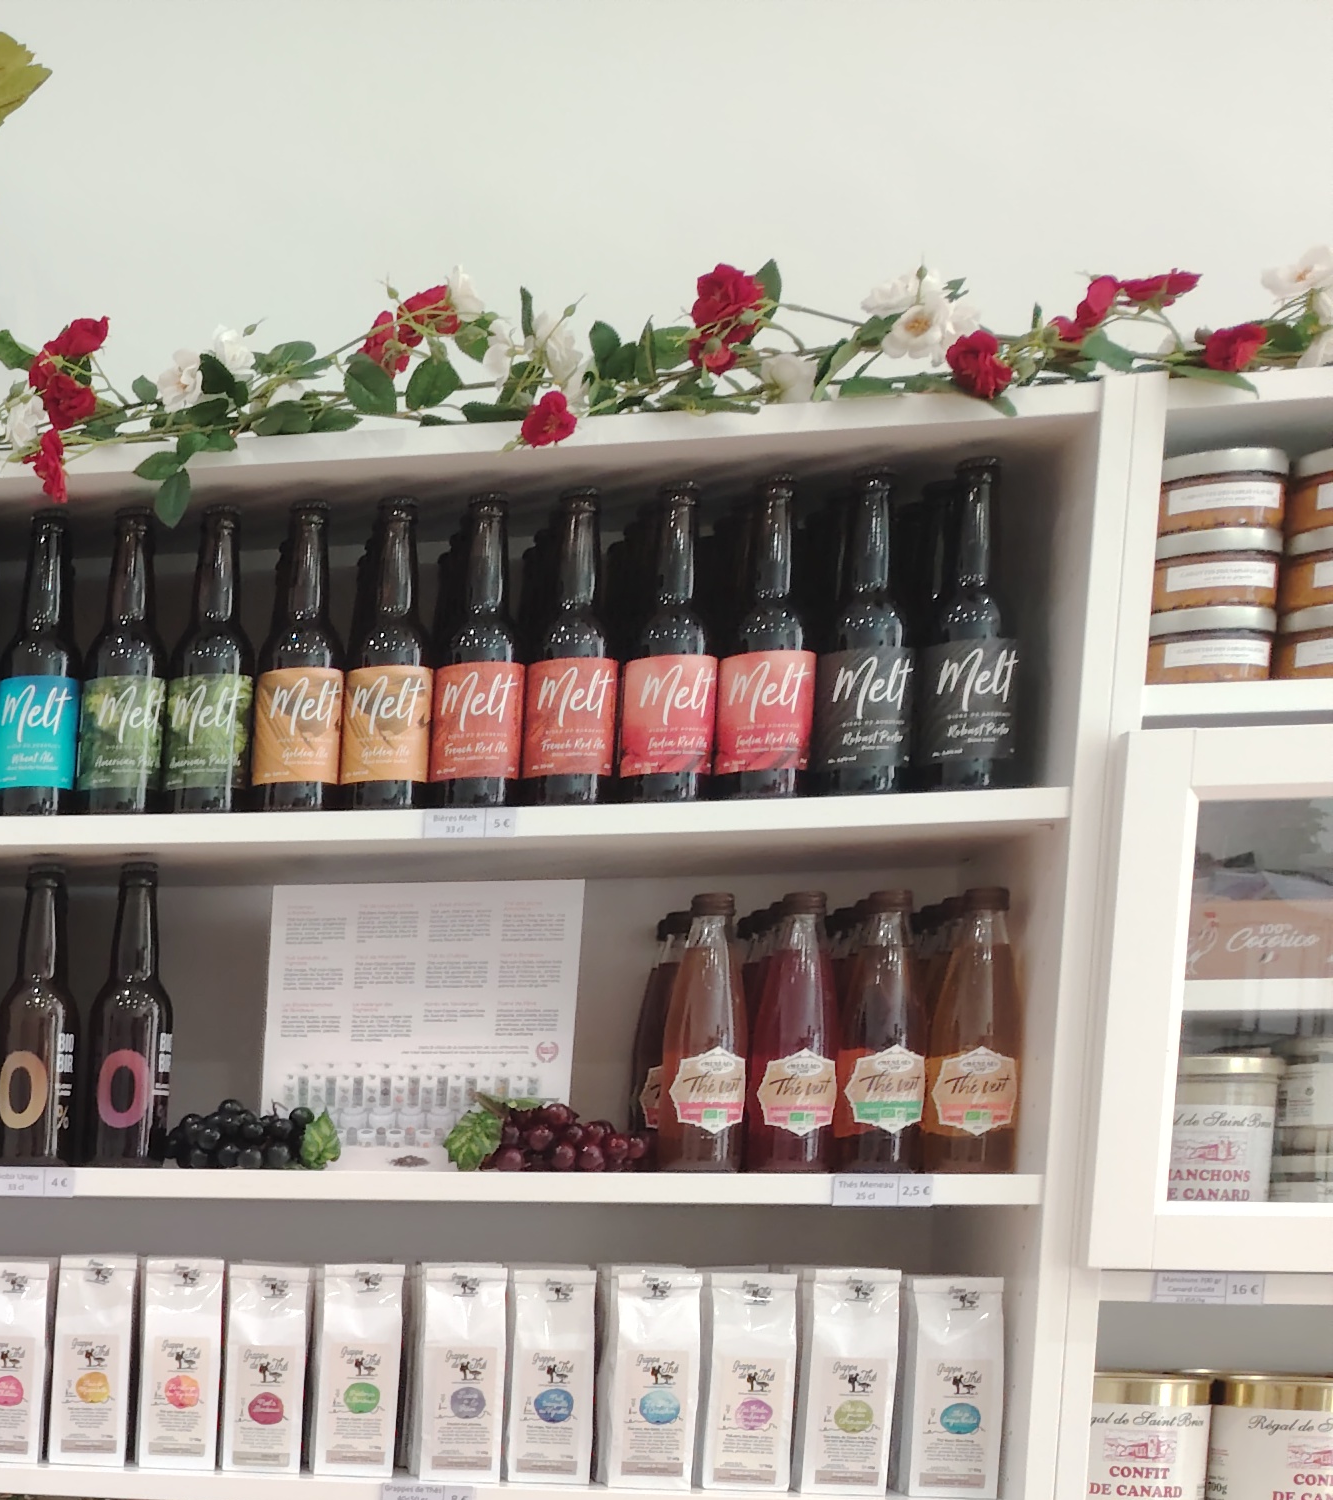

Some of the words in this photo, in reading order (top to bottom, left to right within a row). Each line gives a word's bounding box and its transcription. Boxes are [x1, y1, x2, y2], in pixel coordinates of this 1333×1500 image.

[537, 665, 614, 728] Melt
[639, 664, 717, 727] Melt
[730, 661, 810, 724] Melt
[832, 656, 914, 719] Melt
[936, 648, 1019, 711] Melt
[1, 685, 73, 743] Melt
[270, 676, 342, 735] Melt
[441, 671, 518, 732] Melt
[494, 819, 500, 828] 5
[502, 819, 510, 828] €
[57, 1054, 73, 1073] BIR
[982, 1076, 1012, 1094] vert
[1168, 1169, 1250, 1183] ANCHONS
[1183, 1188, 1250, 1201] CANARD
[1232, 1284, 1247, 1295] 16
[1251, 1284, 1259, 1295] €
[1089, 1483, 1111, 1495] DE
[1117, 1484, 1182, 1498] CANARD
[1109, 1466, 1170, 1479] CONFIT
